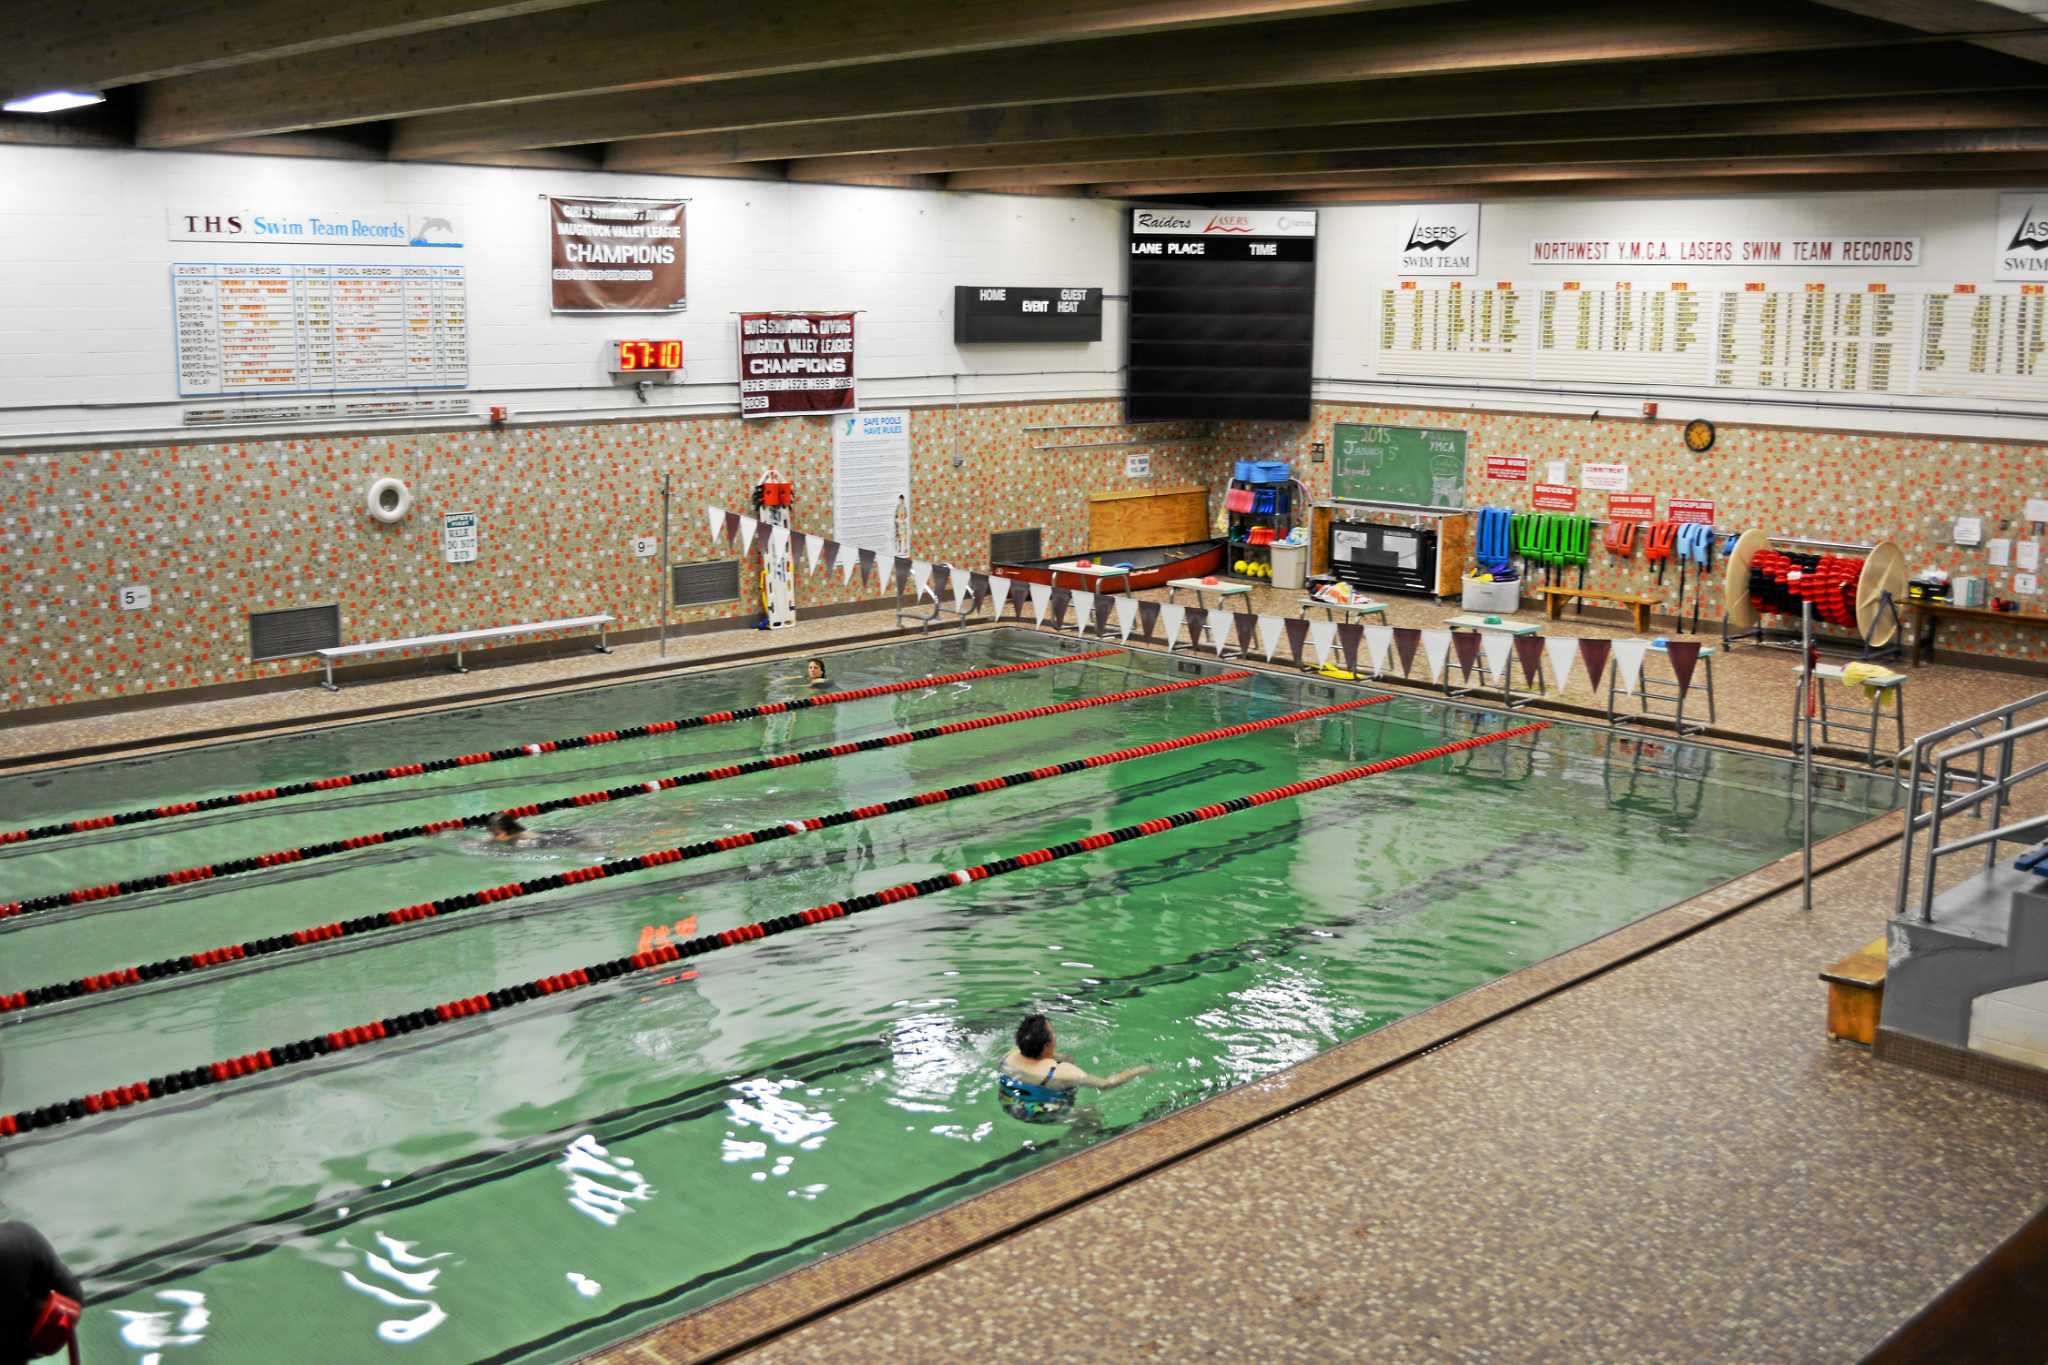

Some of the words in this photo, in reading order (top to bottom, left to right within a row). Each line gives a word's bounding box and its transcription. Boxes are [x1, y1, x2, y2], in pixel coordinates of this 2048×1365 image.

[254, 216, 303, 235] Swim
[309, 218, 349, 236] Team
[351, 218, 406, 238] Records
[1138, 213, 1192, 229] Raiders
[1404, 217, 1460, 251] LASERS
[565, 242, 676, 264] CHAMPIONS
[1131, 243, 1163, 254] LANE
[1167, 243, 1205, 254] PLACE
[1249, 244, 1277, 256] TIME
[1534, 241, 1609, 260] NORTHWEST
[1680, 241, 1733, 260] LASERS
[1742, 241, 1782, 260] SWIM
[1793, 241, 1833, 261] TEAM
[1842, 241, 1913, 262] RECORDS
[1402, 256, 1433, 268] SWIM
[1437, 256, 1470, 268] TEAM
[979, 289, 1007, 301] HOME
[1060, 288, 1088, 301] GUEST
[1022, 301, 1050, 313] EVENT
[1057, 301, 1080, 313] HEAT
[622, 342, 680, 369] 57:10
[750, 358, 847, 374] CHAMPIONS
[863, 417, 880, 426] SAFE
[1360, 427, 1391, 444] 2015
[1429, 440, 1456, 453] YMCA
[125, 591, 136, 605] 5
